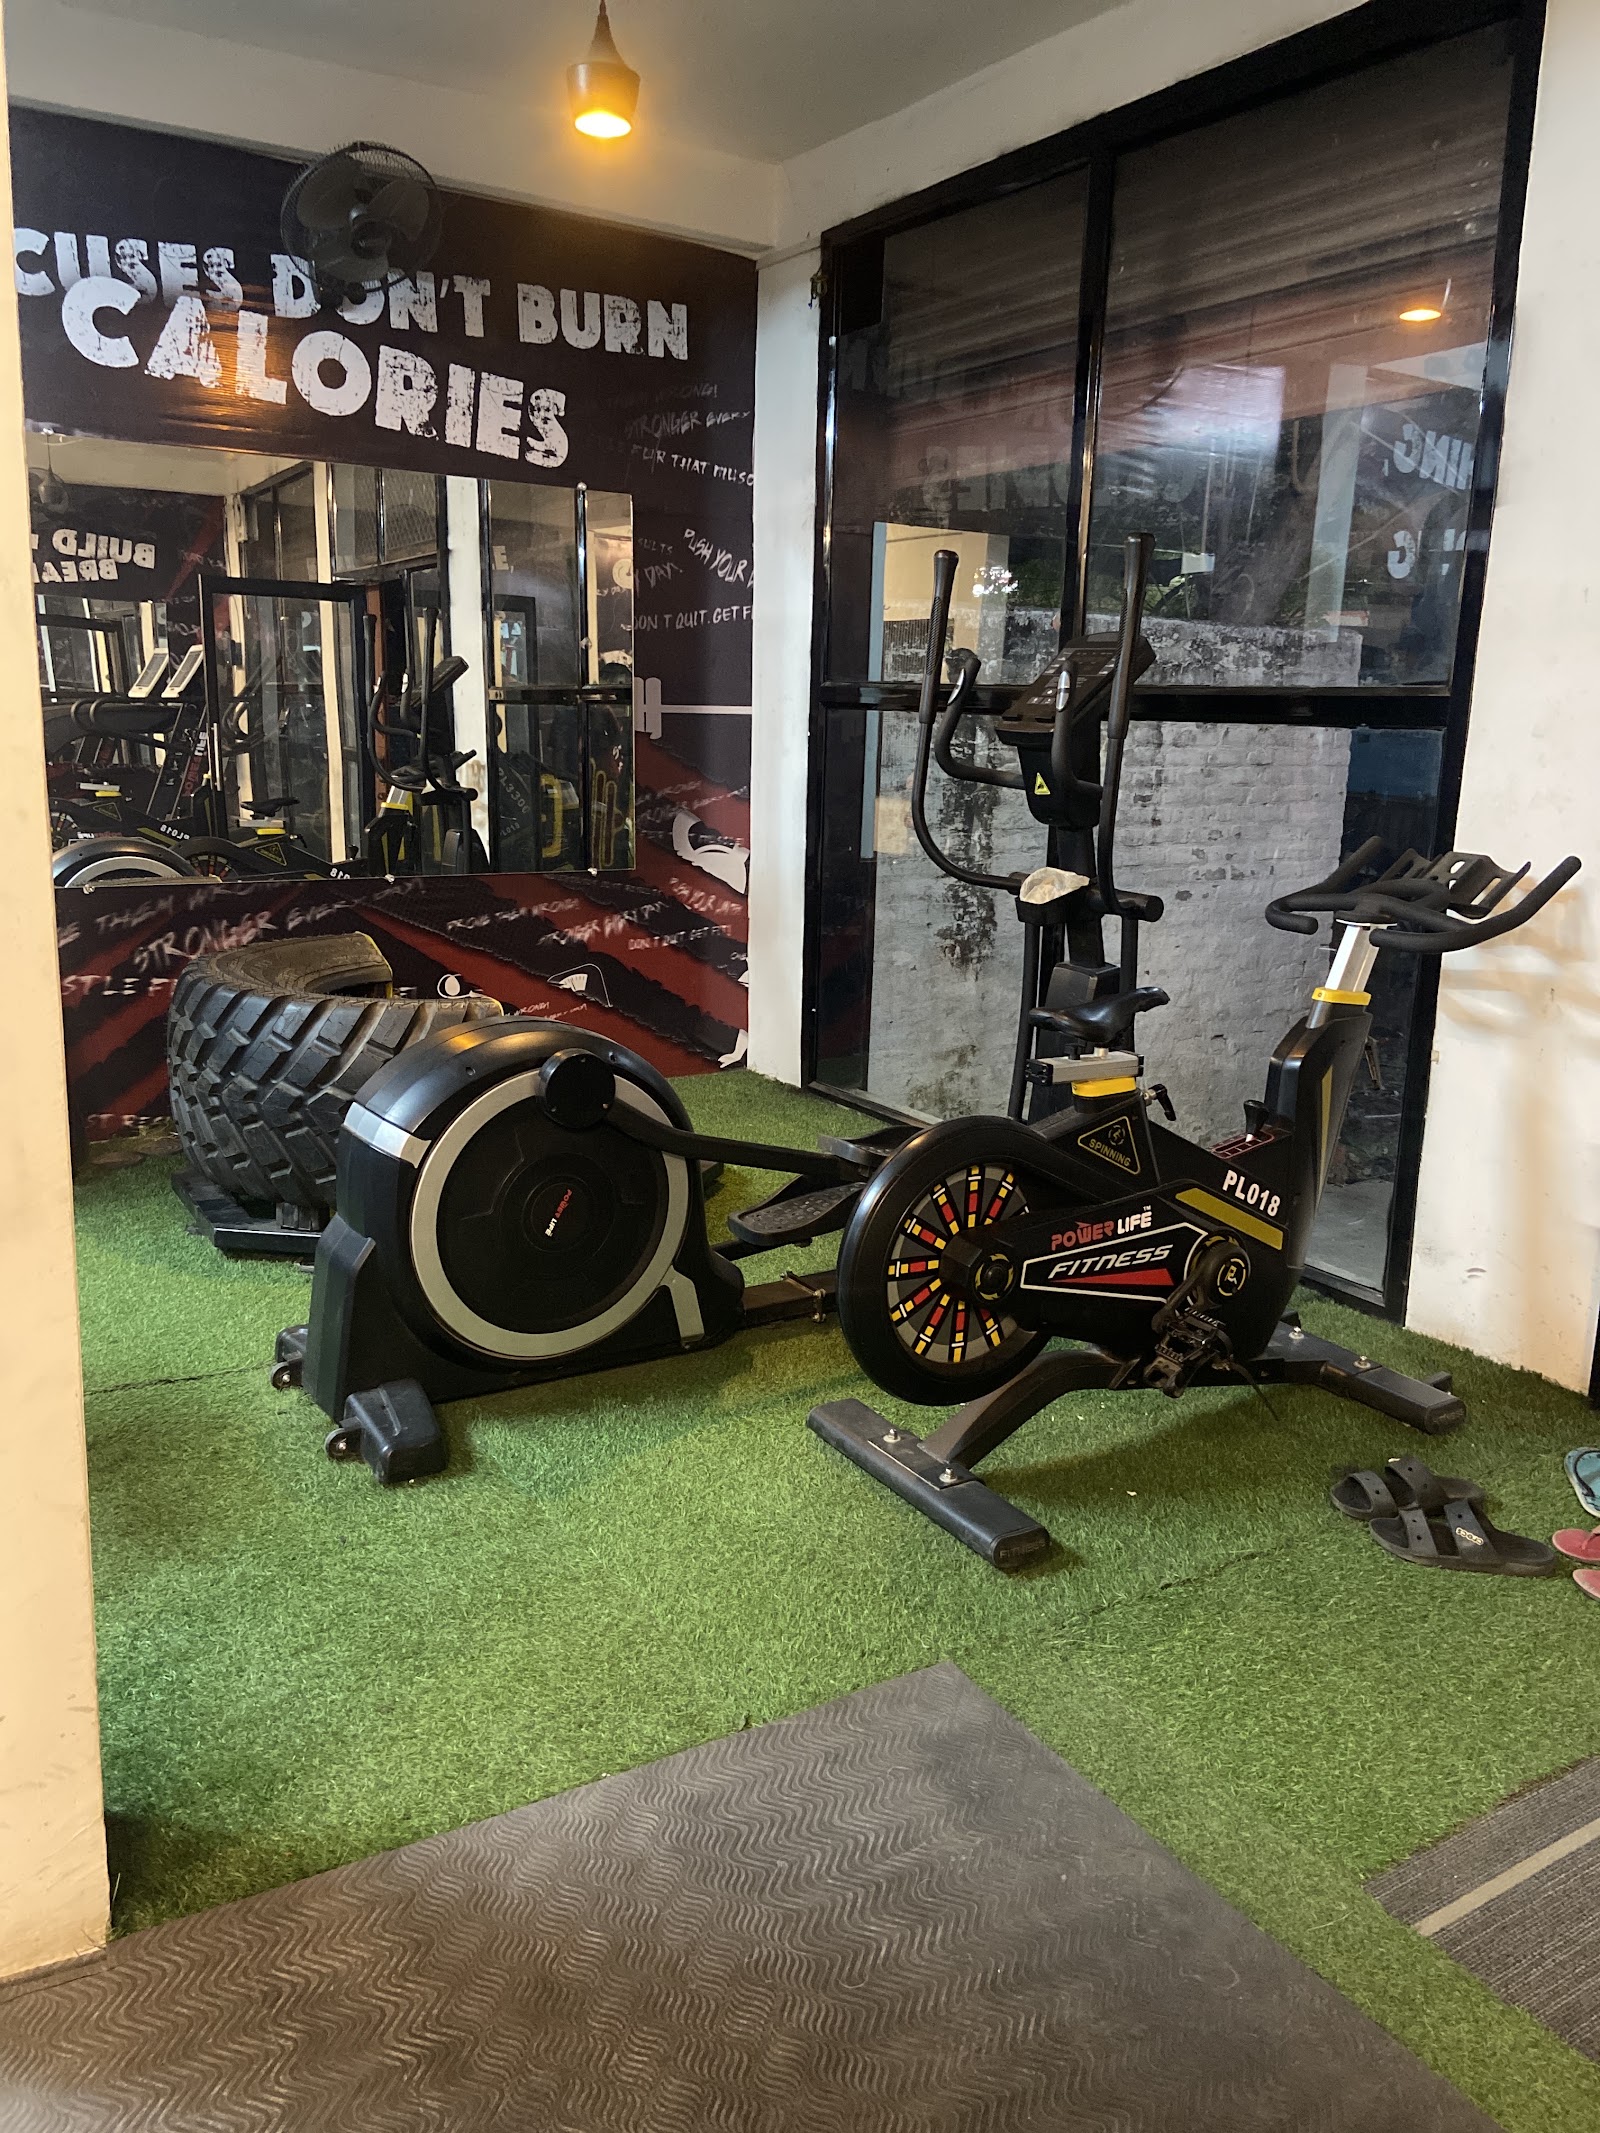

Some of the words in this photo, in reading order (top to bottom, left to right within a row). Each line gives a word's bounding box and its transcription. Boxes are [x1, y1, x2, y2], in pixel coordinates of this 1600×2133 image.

[270, 253, 491, 338] DON'T
[517, 283, 688, 361] BURN
[61, 275, 569, 469] CALORIES
[671, 453, 711, 475] THAT
[683, 528, 714, 565] PUSH
[708, 548, 749, 584] YOUR
[712, 605, 741, 625] GET
[132, 909, 277, 973] STRONGER
[1088, 1138, 1131, 1168] SPINNING
[1222, 1169, 1281, 1218] PL018
[1051, 1220, 1115, 1251] POWER
[1117, 1211, 1152, 1235] LIFE
[1048, 1244, 1173, 1280] FITNESS
